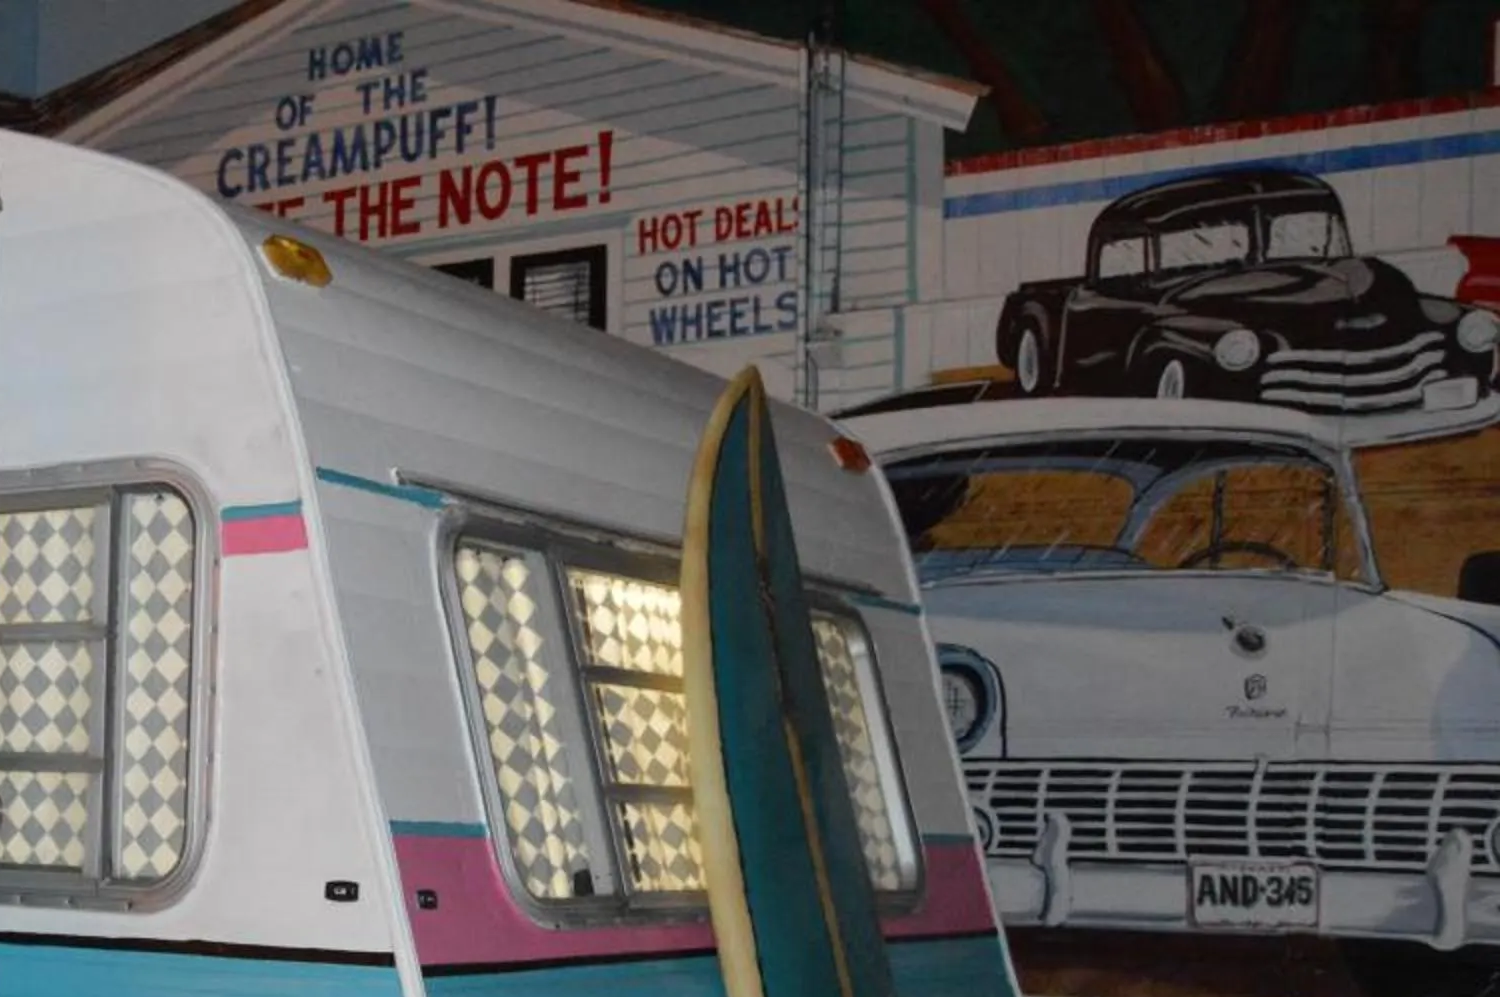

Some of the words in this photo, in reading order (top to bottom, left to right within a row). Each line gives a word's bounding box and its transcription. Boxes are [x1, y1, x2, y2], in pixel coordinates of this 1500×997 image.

[307, 32, 404, 81] HOME
[275, 94, 315, 131] OF
[356, 67, 428, 115] THE
[217, 95, 498, 198] CREAMPUFF!
[323, 175, 422, 241] THE
[437, 130, 613, 229] NOTE!
[638, 210, 704, 256] HOT
[655, 256, 704, 296] ON
[718, 246, 792, 288] HOT
[649, 291, 799, 346] WHEELS
